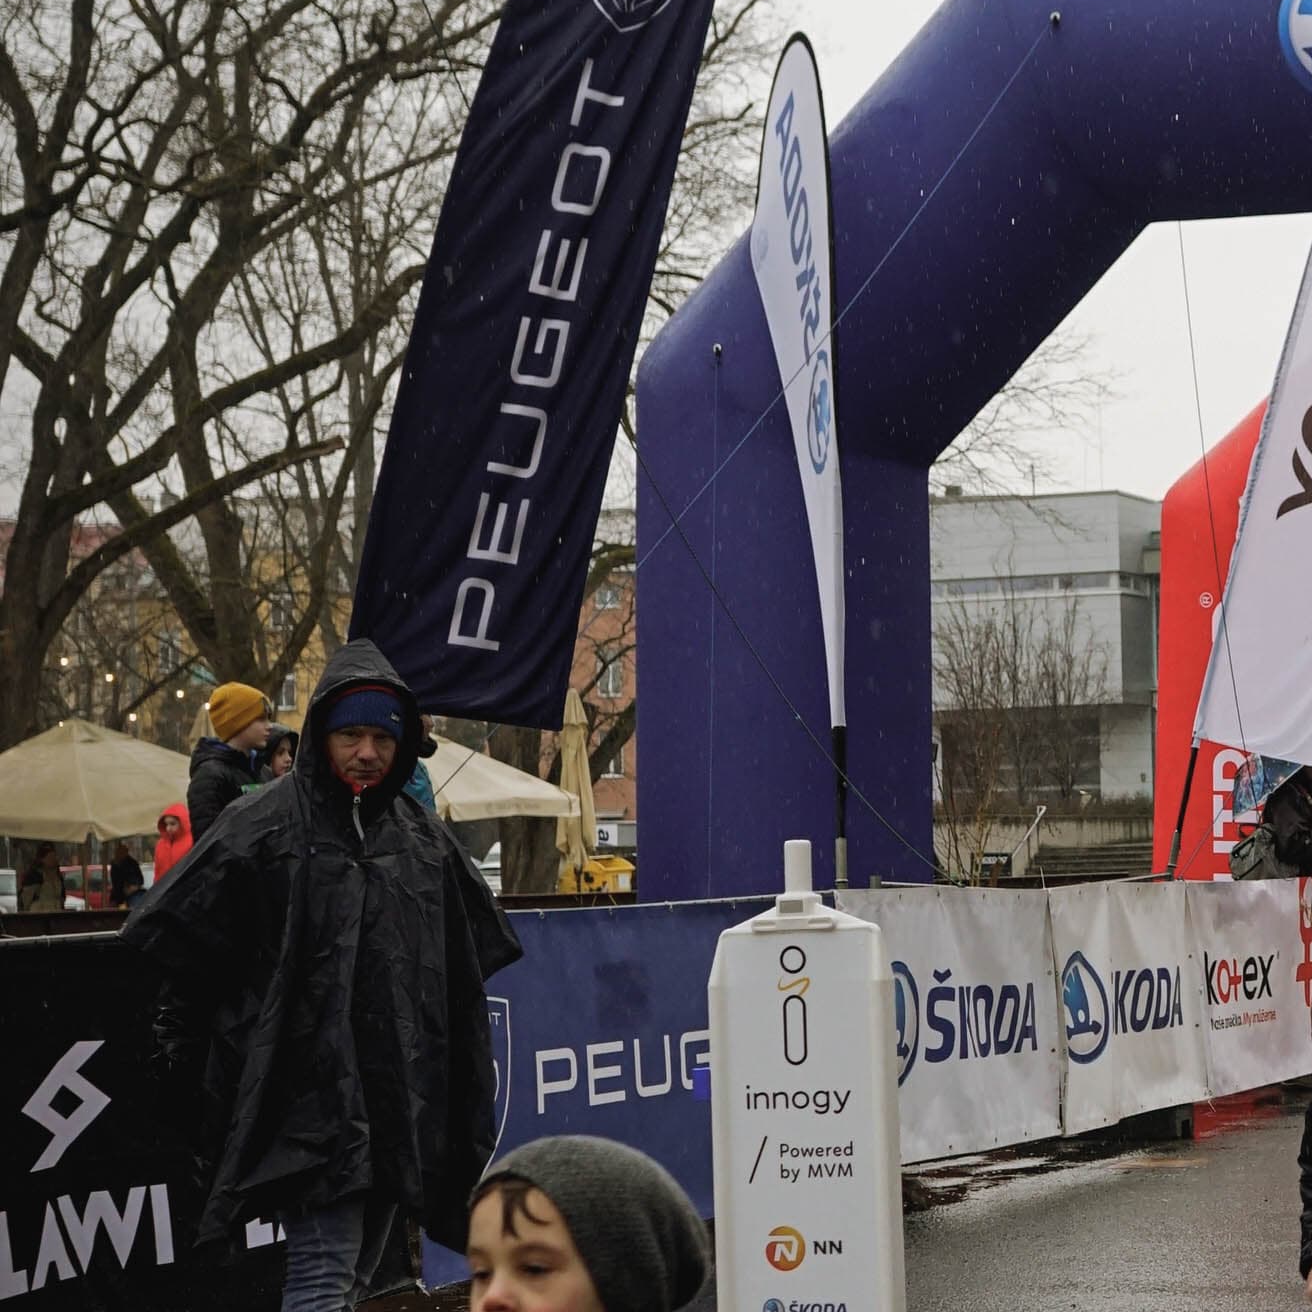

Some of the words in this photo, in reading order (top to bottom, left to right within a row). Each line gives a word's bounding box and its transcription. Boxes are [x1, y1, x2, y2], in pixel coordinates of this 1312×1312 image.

[448, 58, 626, 652] PEUGEOT
[924, 967, 1038, 1064] ŠKODA
[1111, 964, 1184, 1036] KODA
[535, 1029, 709, 1114] PEUG
[745, 1085, 851, 1115] innogy
[780, 1141, 853, 1159] Powered
[780, 1163, 800, 1182] by
[807, 1163, 853, 1179] MVM
[0, 1183, 175, 1301] LAWI
[812, 1239, 843, 1256] NN
